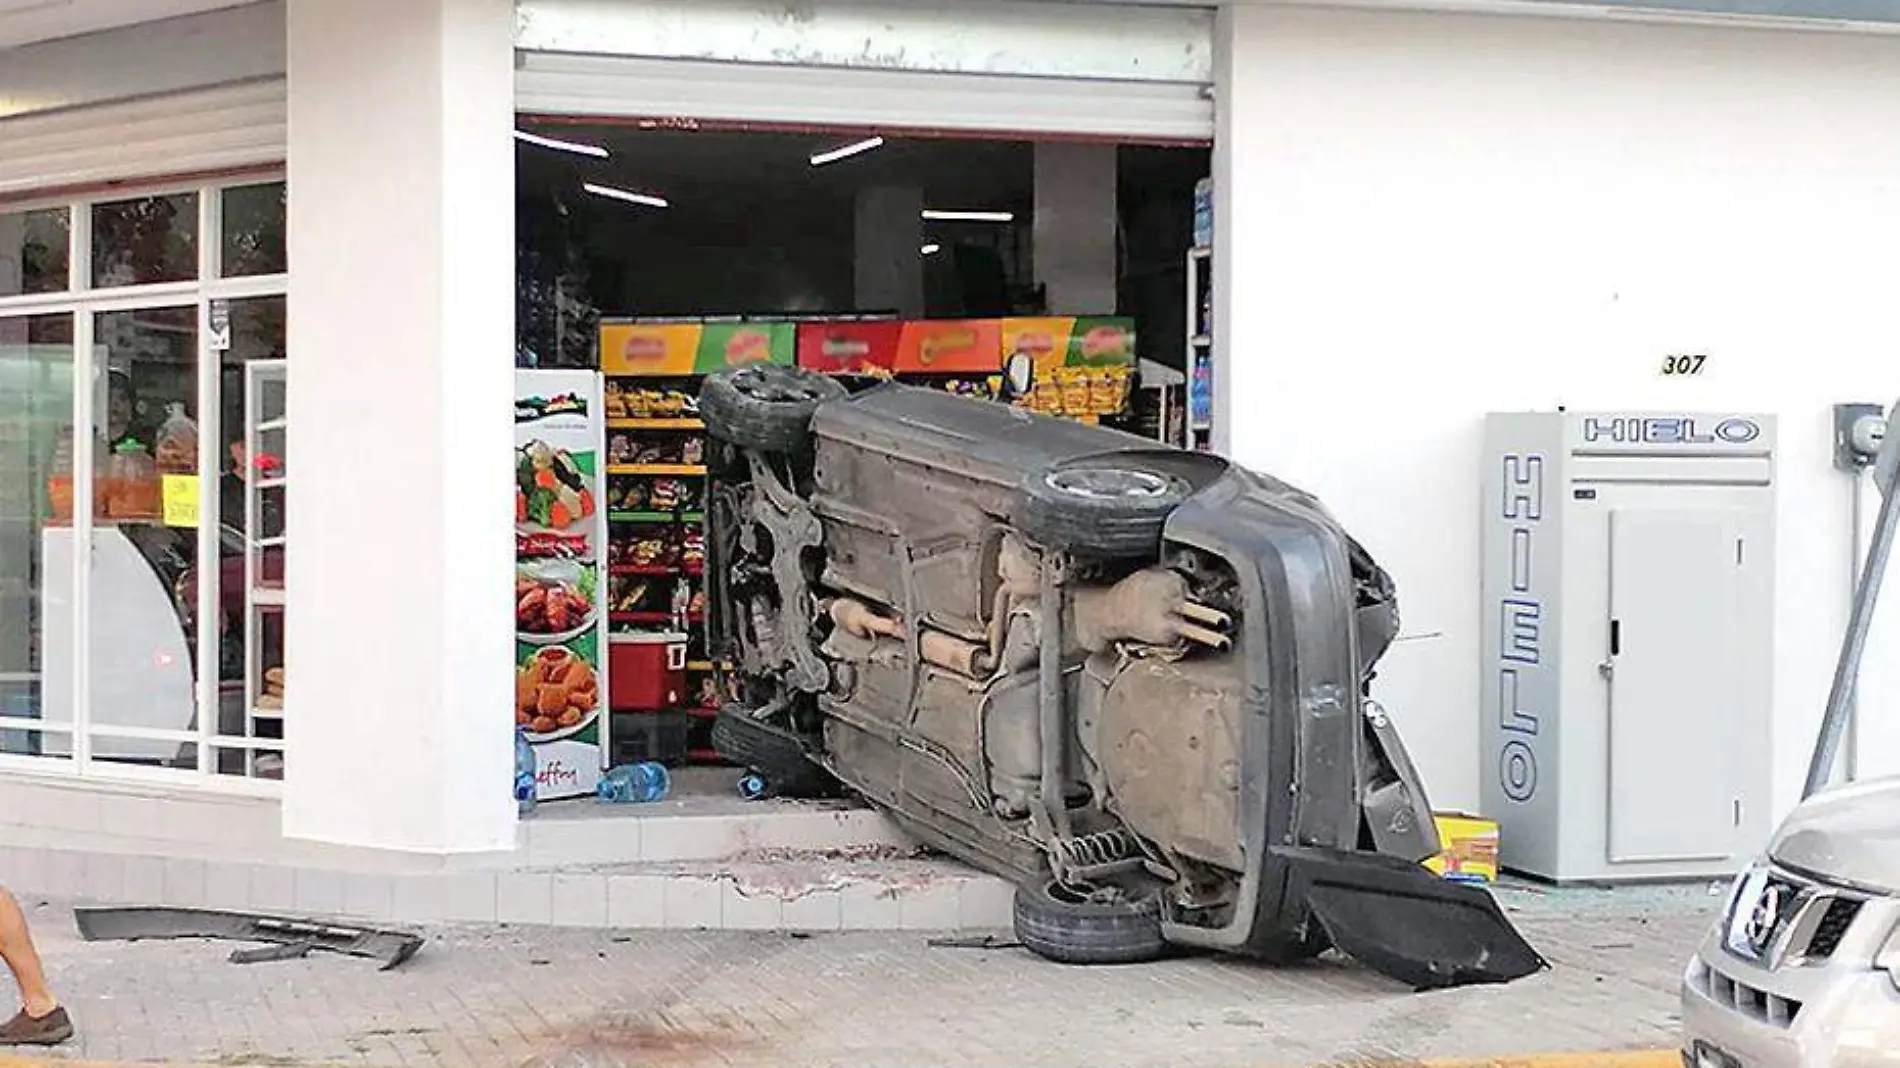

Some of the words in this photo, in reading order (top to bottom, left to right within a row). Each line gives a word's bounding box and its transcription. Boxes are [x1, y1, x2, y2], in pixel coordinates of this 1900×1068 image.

[1663, 355, 1707, 374] 307
[1584, 417, 1760, 443] HIELO
[1499, 455, 1542, 802] HIELO
